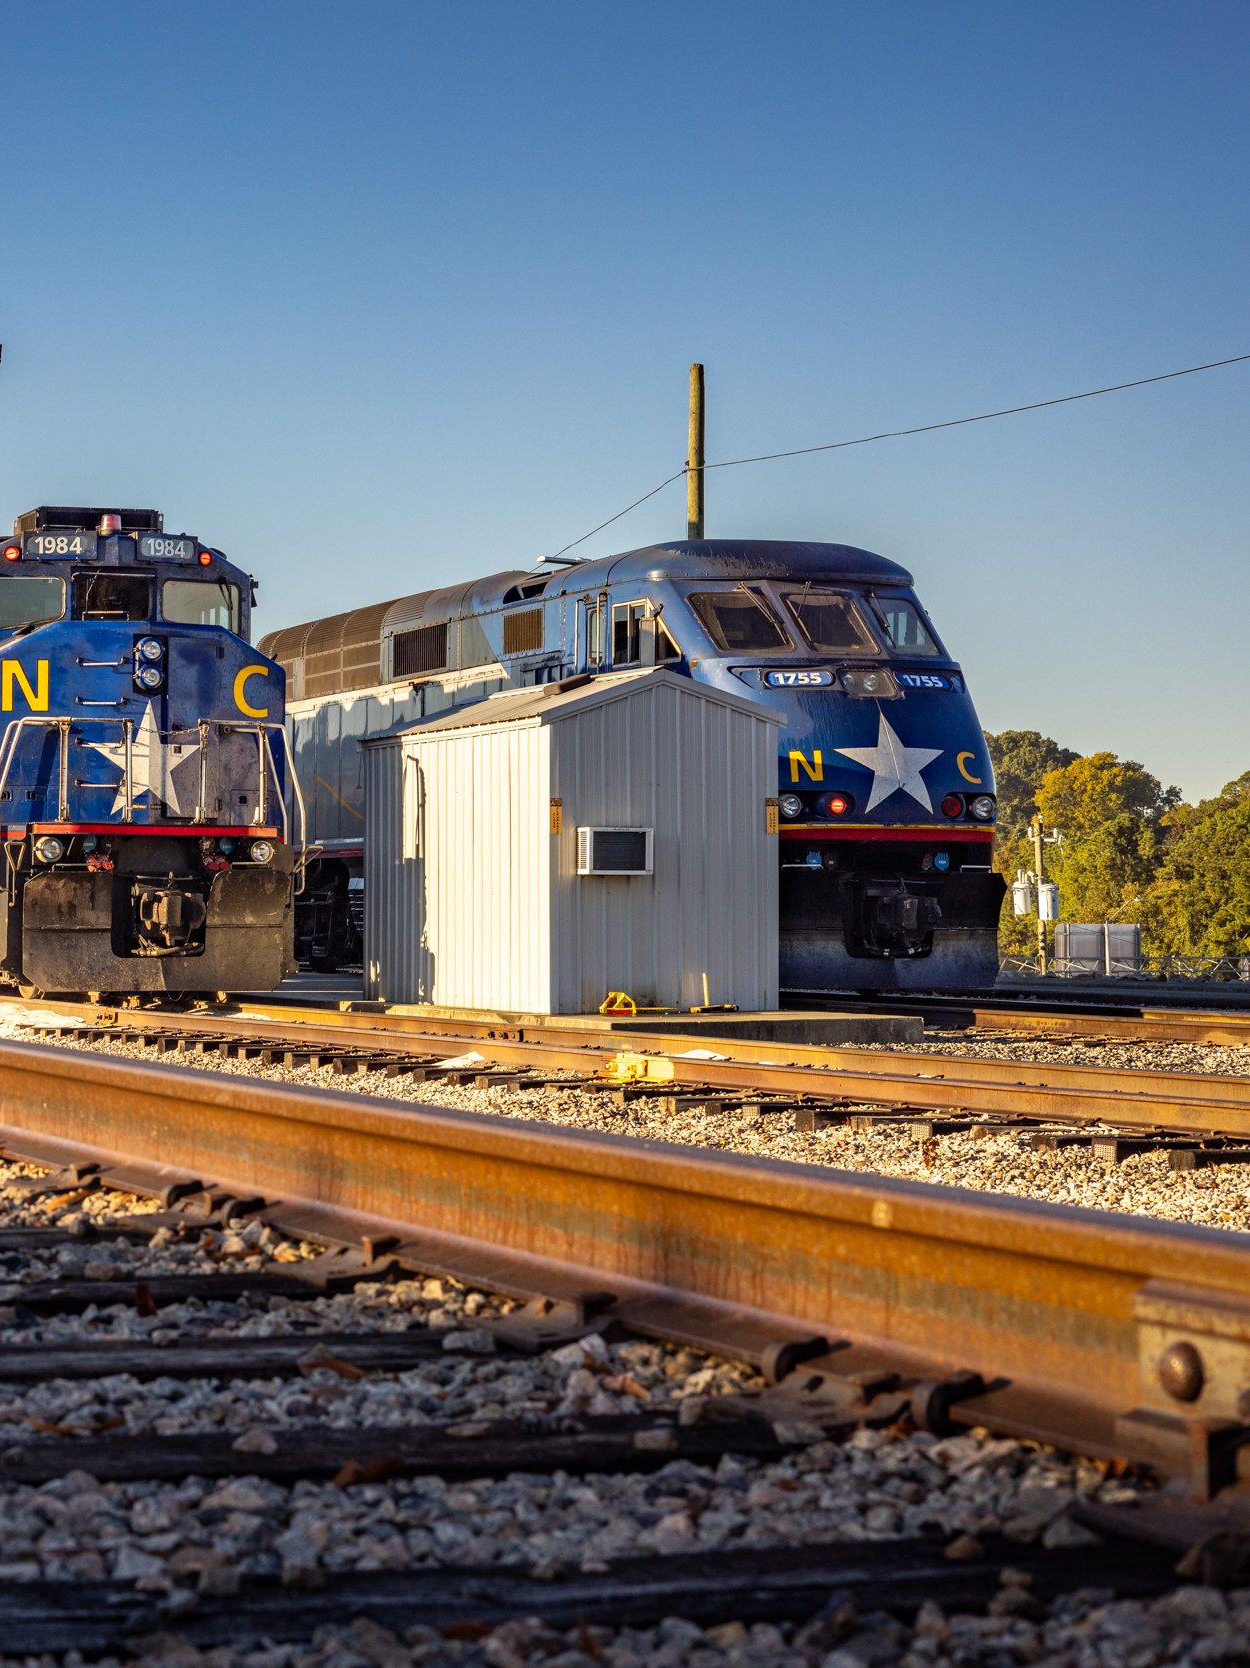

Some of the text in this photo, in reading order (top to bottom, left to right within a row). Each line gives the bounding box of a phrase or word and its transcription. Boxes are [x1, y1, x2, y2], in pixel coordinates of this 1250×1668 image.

[34, 536, 83, 555] 1984
[146, 537, 187, 558] 1984
[0, 659, 50, 713] N
[233, 664, 270, 719] C
[774, 671, 823, 686] 1755
[902, 673, 944, 689] 1755
[788, 749, 824, 783] N
[956, 751, 982, 785] C
